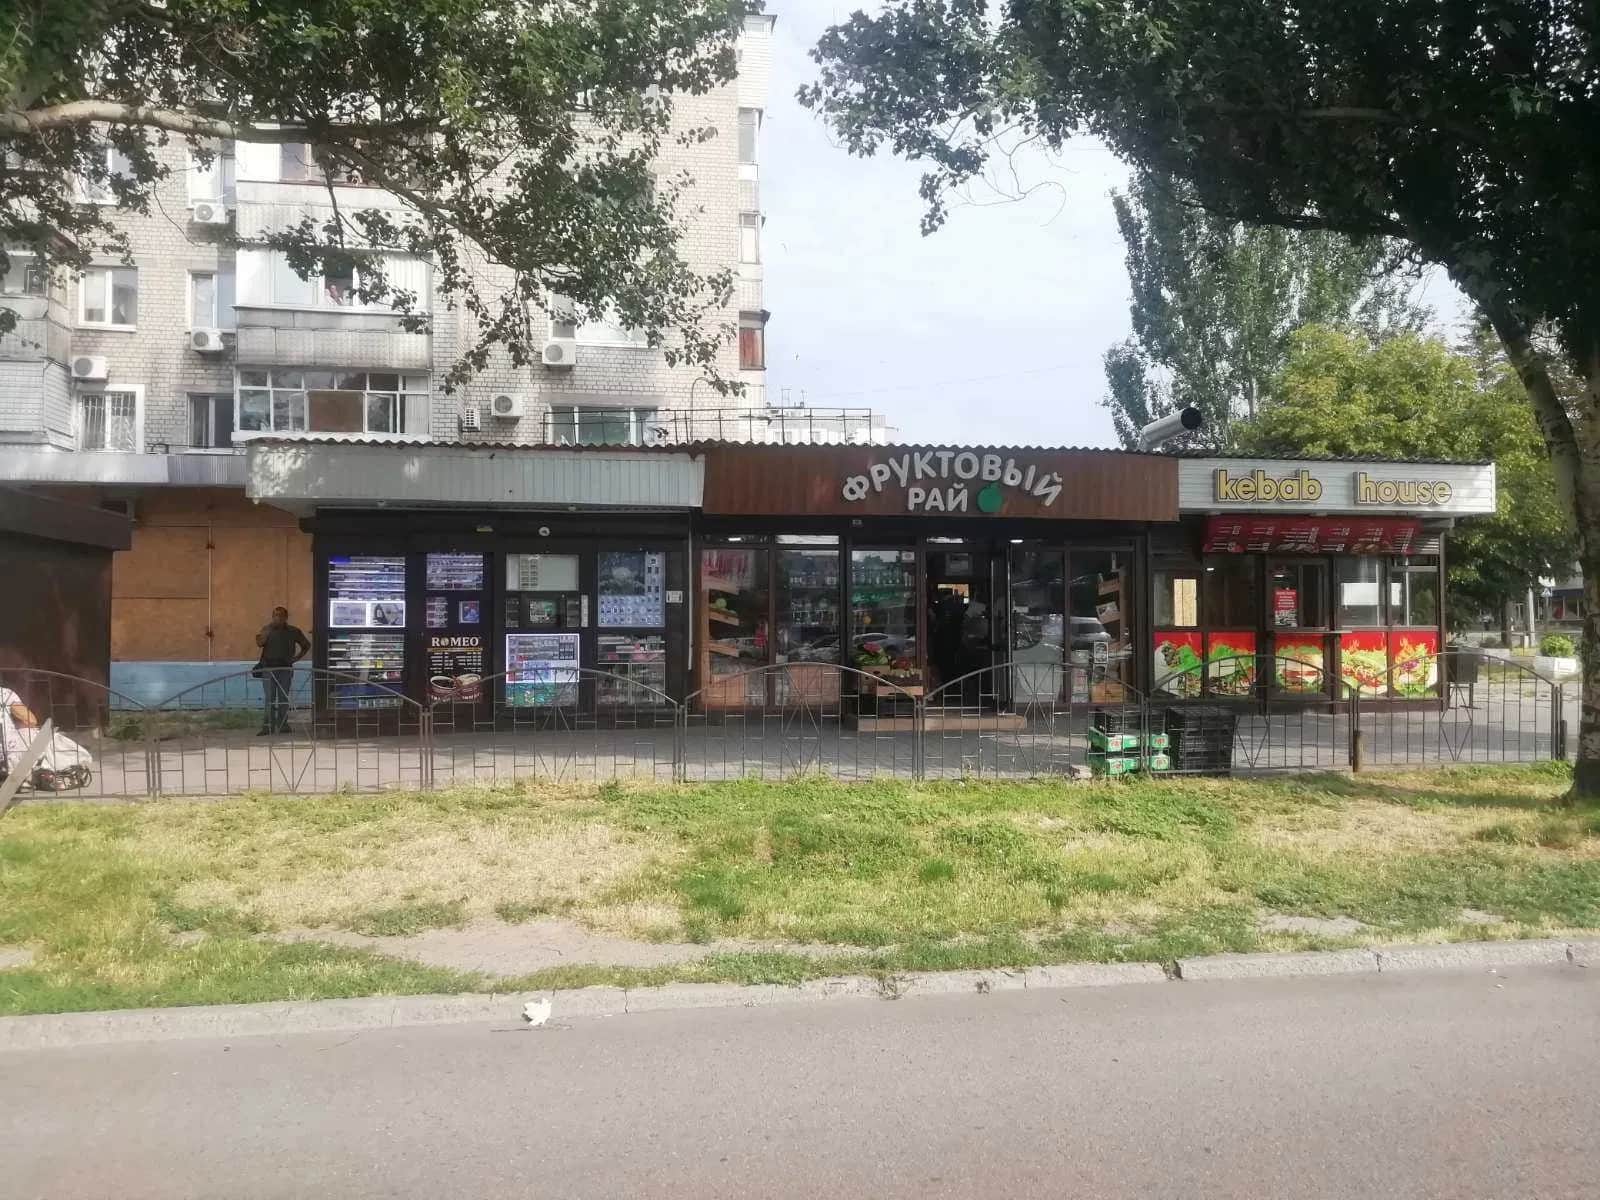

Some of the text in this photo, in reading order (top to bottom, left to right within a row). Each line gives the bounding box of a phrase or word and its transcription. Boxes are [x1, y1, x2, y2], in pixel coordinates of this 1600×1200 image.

[842, 451, 1062, 506] ФРУКТОВЫЙ
[1218, 469, 1453, 503] kebab house
[908, 482, 968, 512] РАЙ
[431, 636, 479, 647] ROMEO
